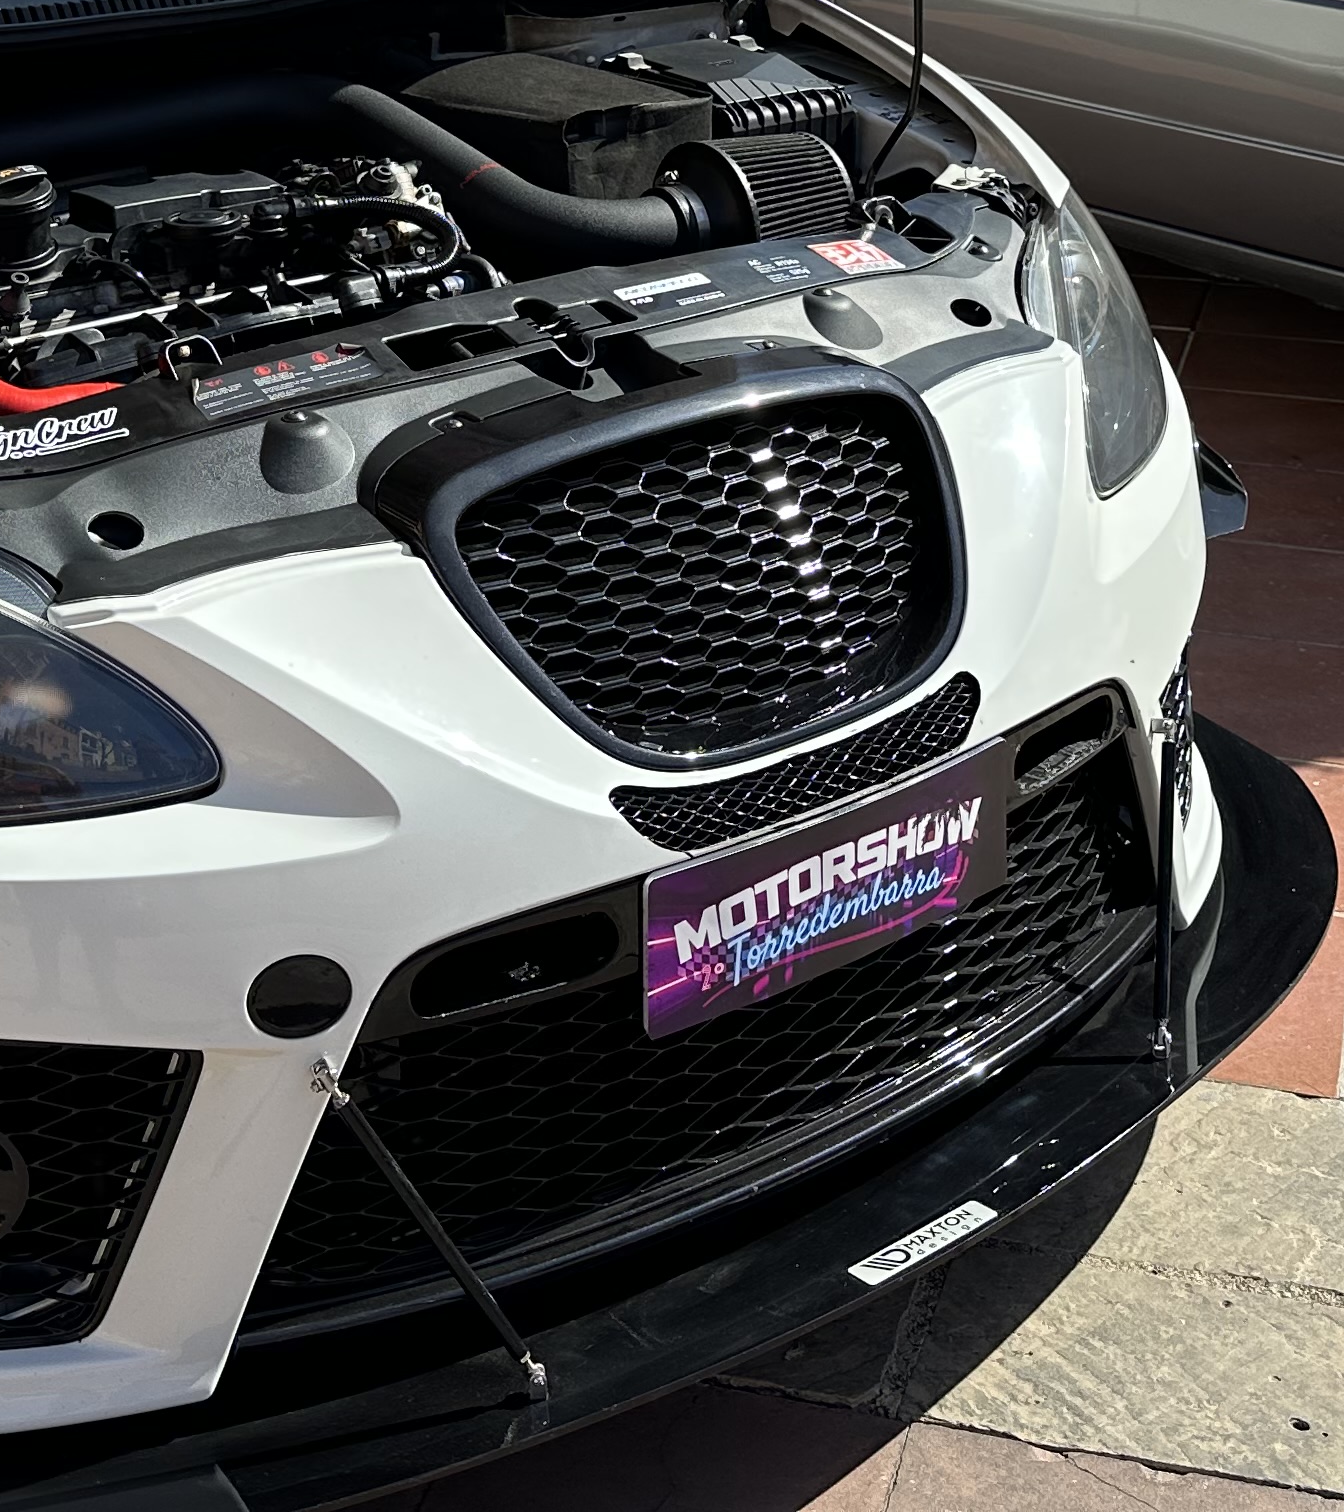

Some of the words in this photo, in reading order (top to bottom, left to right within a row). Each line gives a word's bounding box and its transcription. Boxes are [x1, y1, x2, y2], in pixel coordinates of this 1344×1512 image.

[674, 797, 982, 963] MOTORSHOW
[727, 866, 945, 986] Torredembarra
[905, 1208, 974, 1252] MAXTON
